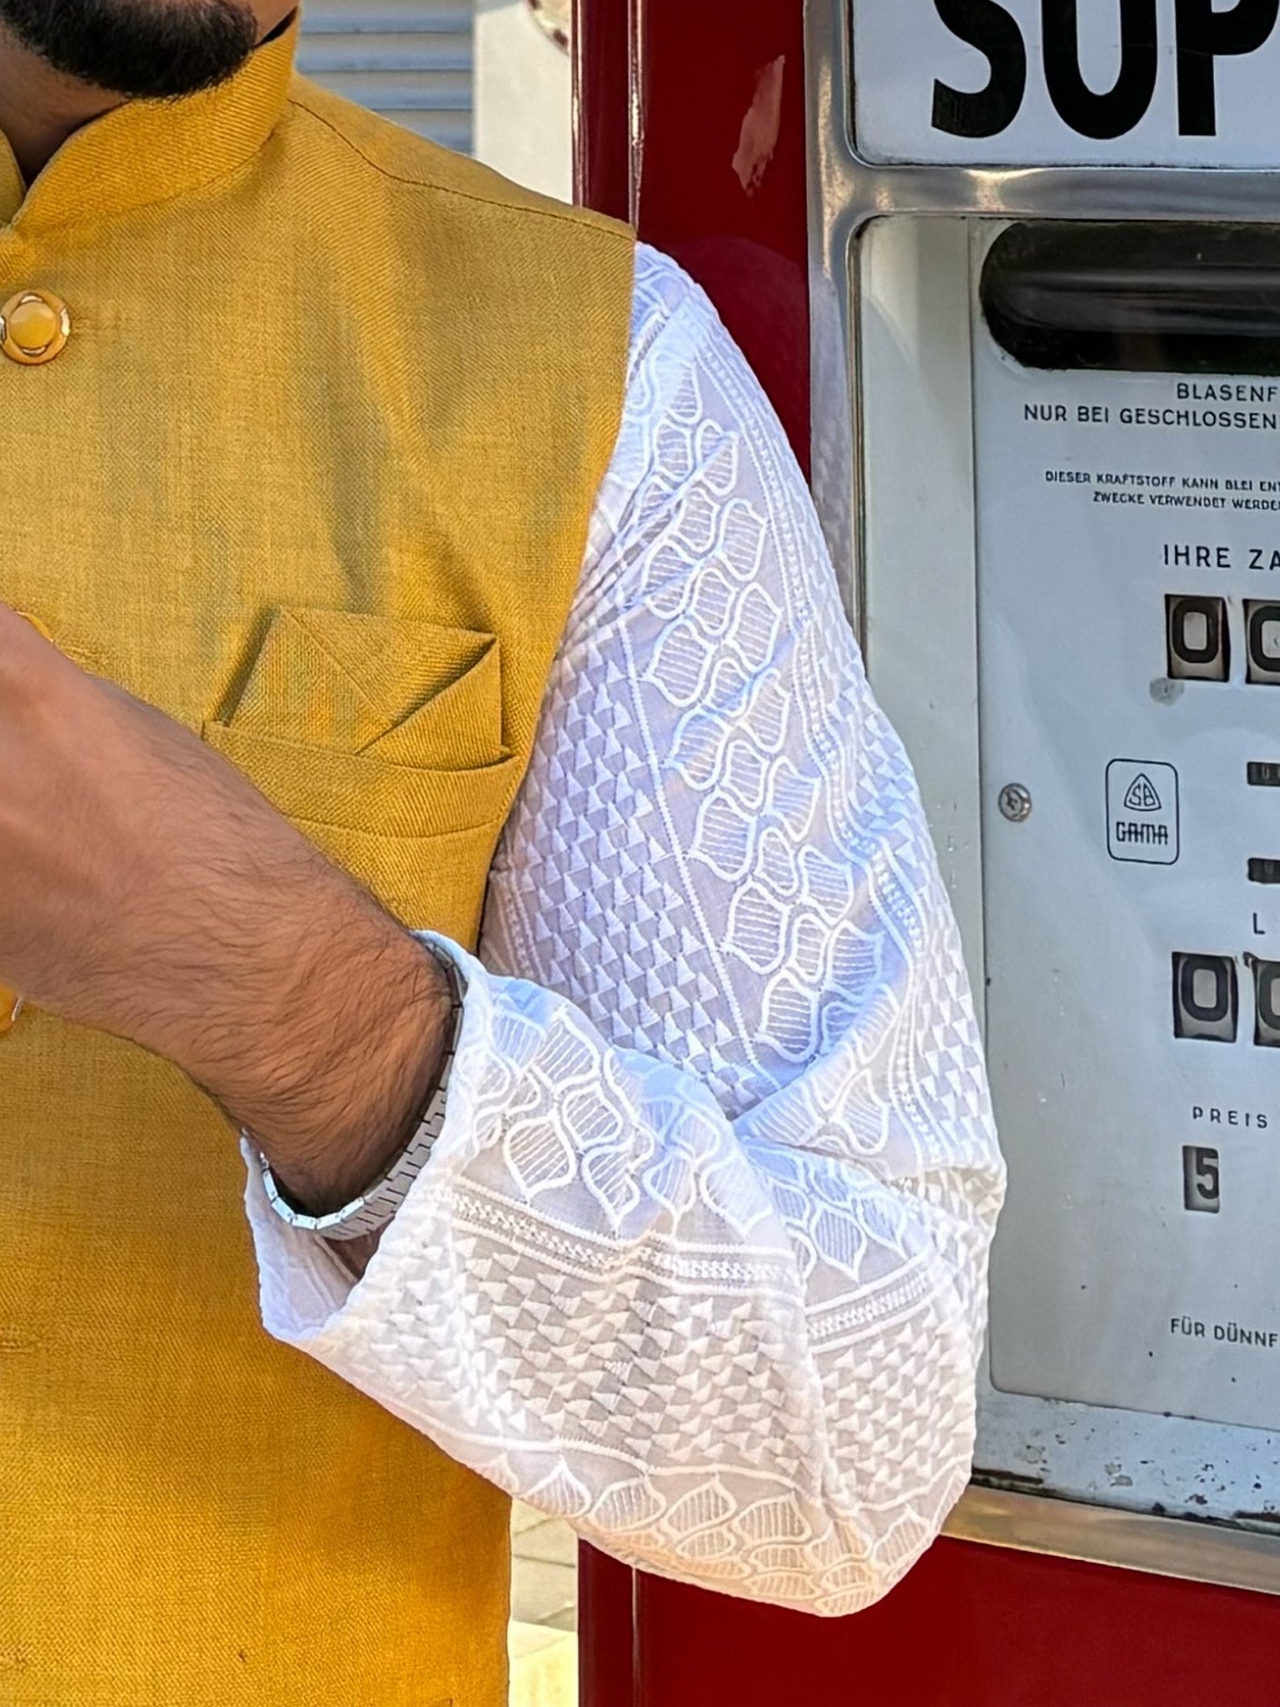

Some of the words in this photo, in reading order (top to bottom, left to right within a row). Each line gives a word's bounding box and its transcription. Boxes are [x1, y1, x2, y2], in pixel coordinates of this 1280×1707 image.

[1024, 404, 1067, 421] NUR
[1078, 406, 1109, 423] BEI
[1046, 471, 1091, 483] DIESER
[1097, 474, 1175, 487] KRAFTSTOFF
[1182, 478, 1218, 489] KANN
[1093, 491, 1144, 504] ZWECKE
[1149, 495, 1226, 508] VERWENDET
[1164, 544, 1231, 568] IHRE
[1193, 1106, 1267, 1128] PREIS
[1171, 1316, 1205, 1337] FÜR
